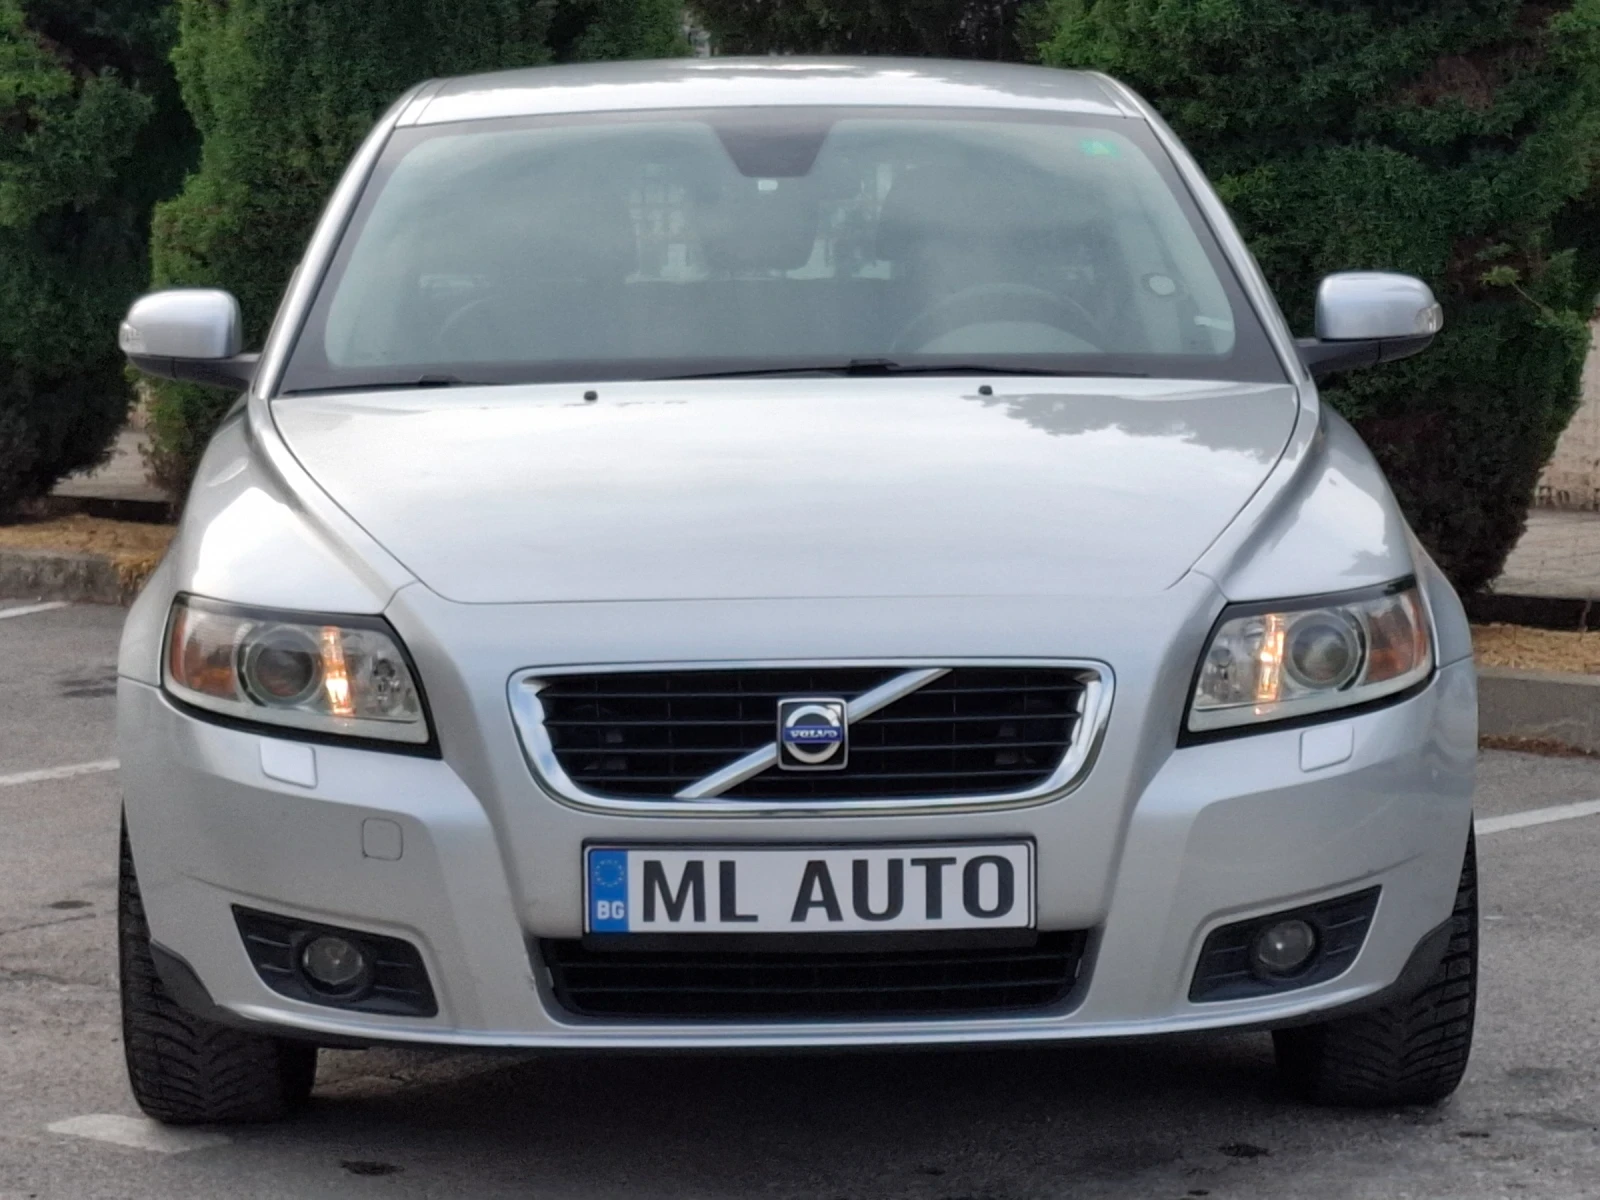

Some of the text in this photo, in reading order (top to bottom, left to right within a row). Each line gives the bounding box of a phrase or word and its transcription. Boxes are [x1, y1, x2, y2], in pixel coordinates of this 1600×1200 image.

[790, 729, 838, 738] VOLVO
[642, 855, 1015, 923] ML AUTO
[597, 900, 625, 920] BG
